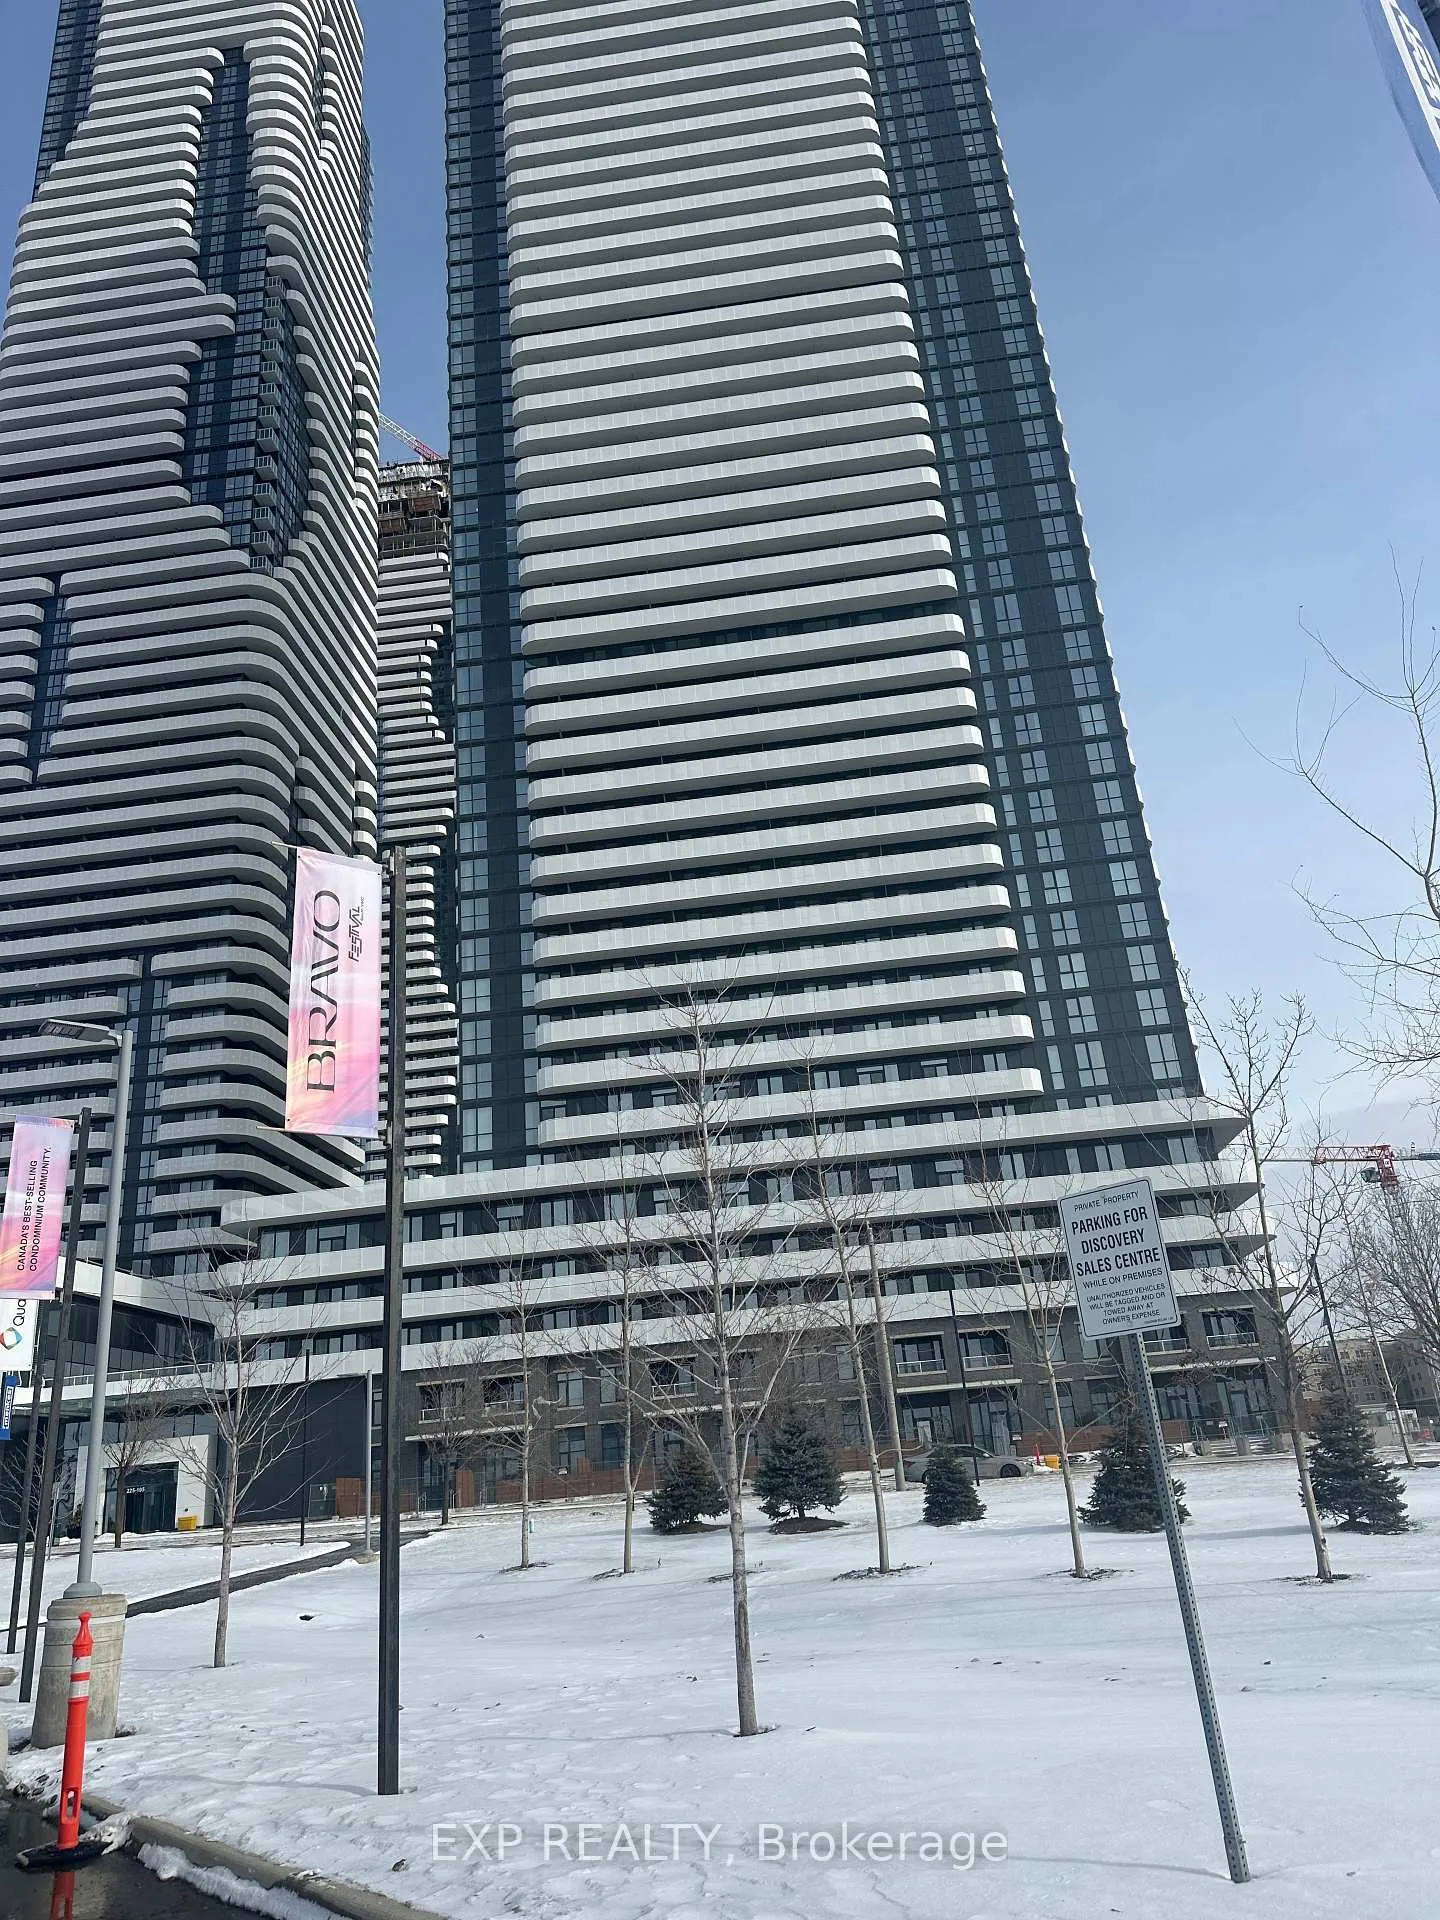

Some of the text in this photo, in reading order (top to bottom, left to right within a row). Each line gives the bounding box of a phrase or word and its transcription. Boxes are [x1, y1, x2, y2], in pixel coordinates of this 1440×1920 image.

[348, 905, 363, 963] FESTIVAL
[307, 890, 340, 1092] BRAVO
[29, 1146, 52, 1272] CONDOMINIUM COMMUNITY.
[1074, 1190, 1140, 1213] PRIVATE PROPERTY
[17, 1160, 38, 1271] CANADA'S BEST-SELLING
[1071, 1206, 1149, 1236] PARKING FOR
[1081, 1228, 1145, 1254] DISCOVERY
[1076, 1247, 1161, 1277] SALES CENTRE
[1082, 1268, 1163, 1290] WHILE ON PREMISES
[1086, 1282, 1166, 1303] UNAUTHORIZED VEHICLES
[1089, 1303, 1104, 1311] WILL
[1114, 1296, 1140, 1306] TAGGED
[1141, 1293, 1154, 1301] AND
[1156, 1291, 1166, 1299] OR
[1103, 1307, 1126, 1317] TOWED
[1127, 1303, 1144, 1312] AWAY
[1132, 1309, 1160, 1320] EXPENSE
